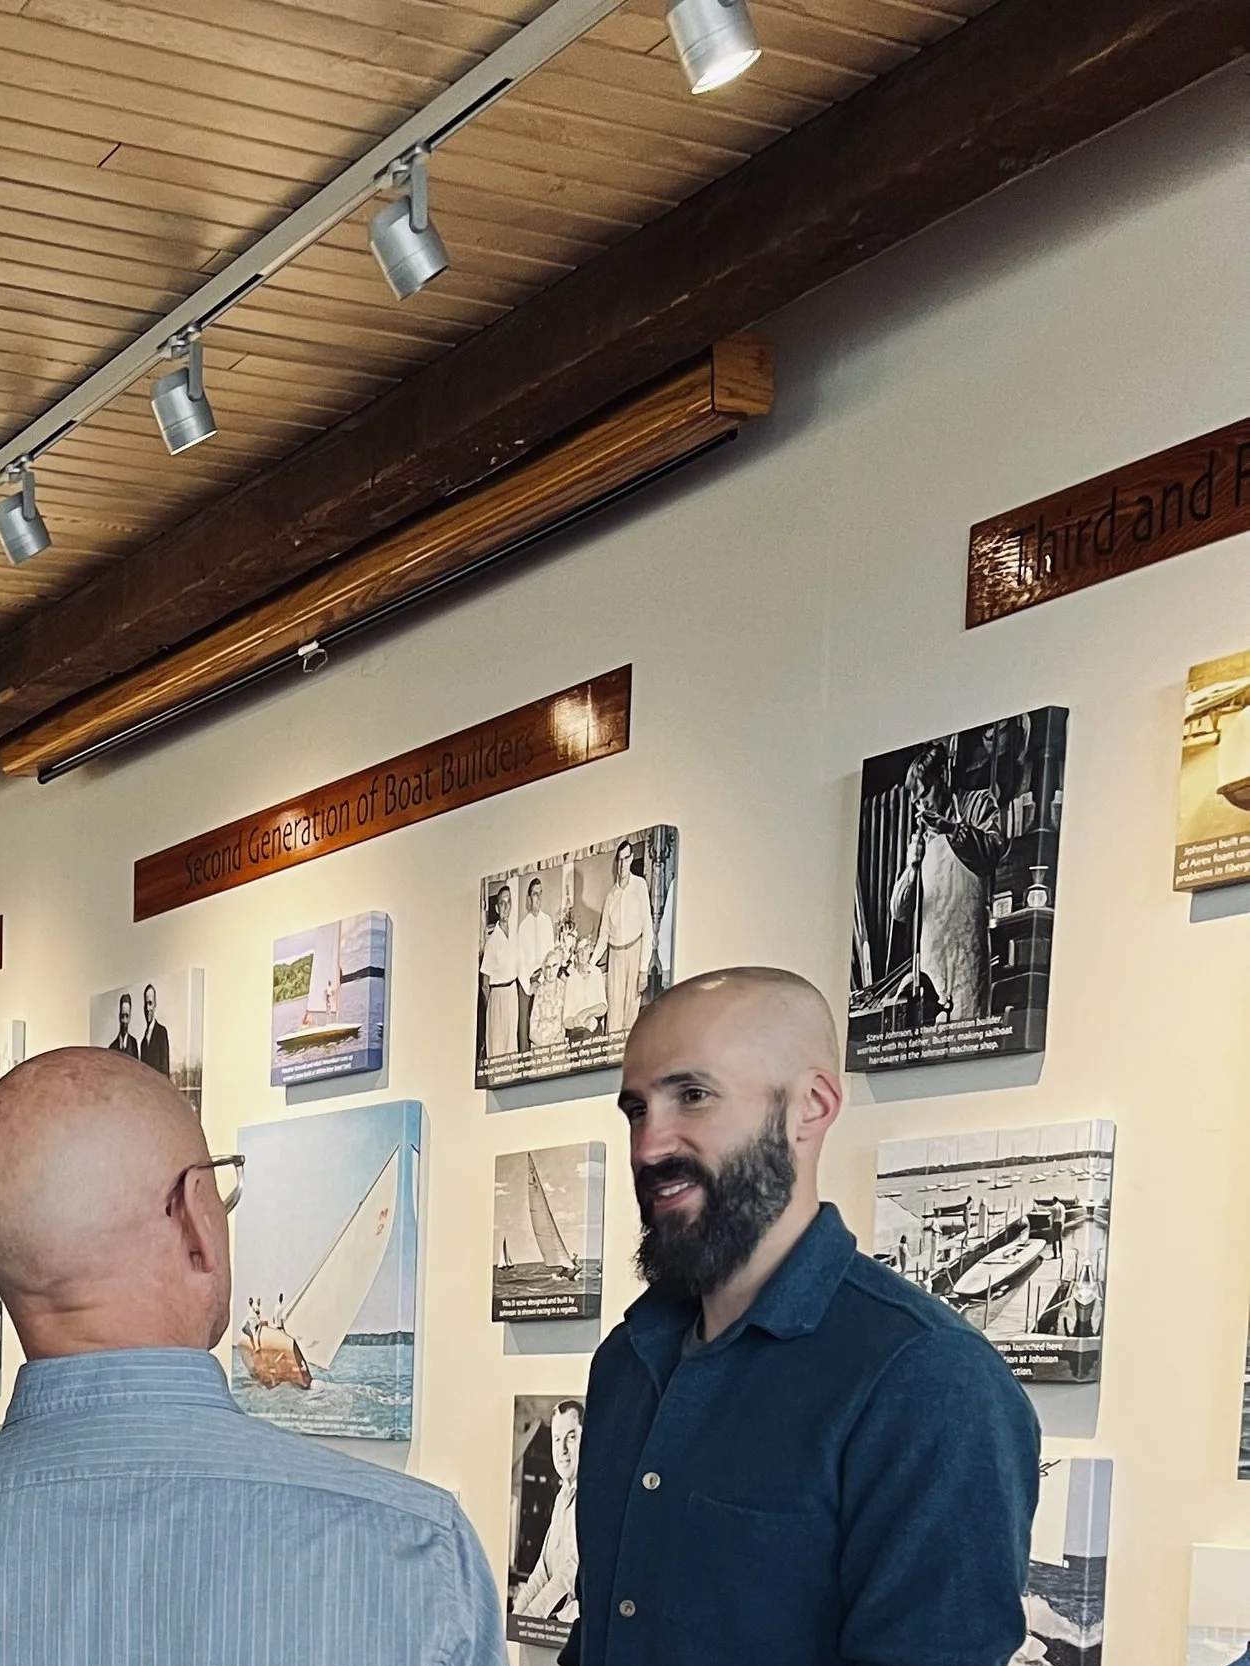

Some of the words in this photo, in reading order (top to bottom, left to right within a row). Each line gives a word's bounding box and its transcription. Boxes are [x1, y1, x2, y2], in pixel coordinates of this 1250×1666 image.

[1007, 487, 1117, 586] Third
[1132, 450, 1215, 542] and
[186, 831, 242, 889] Second
[249, 800, 349, 863] Generation
[357, 776, 378, 825] of
[385, 768, 433, 816] Boat
[442, 730, 533, 795] Builders
[1183, 842, 1217, 856] Johnson
[1179, 859, 1189, 870] of
[1213, 852, 1234, 862] foam
[1176, 869, 1213, 886] problems
[1214, 867, 1223, 875] in
[866, 1033, 883, 1043] Steve
[885, 1029, 913, 1040] Johnson,
[920, 1024, 936, 1035] third
[937, 1020, 975, 1034] generation
[976, 1015, 1003, 1026] builder,
[856, 1045, 881, 1055] worked
[882, 1042, 897, 1052] with
[898, 1040, 907, 1049] his
[958, 1030, 983, 1042] making
[984, 1026, 1013, 1037] sailboat
[869, 1054, 899, 1064] hardware
[900, 1053, 907, 1061] in
[908, 1051, 920, 1060] the
[921, 1047, 948, 1058] Johnson
[949, 1044, 979, 1055] machine
[1012, 1342, 1045, 1351] launched
[1046, 1342, 1063, 1351] here
[1019, 1355, 1027, 1363] at
[1028, 1355, 1058, 1364] Johnson
[1011, 1367, 1033, 1376] ction.
